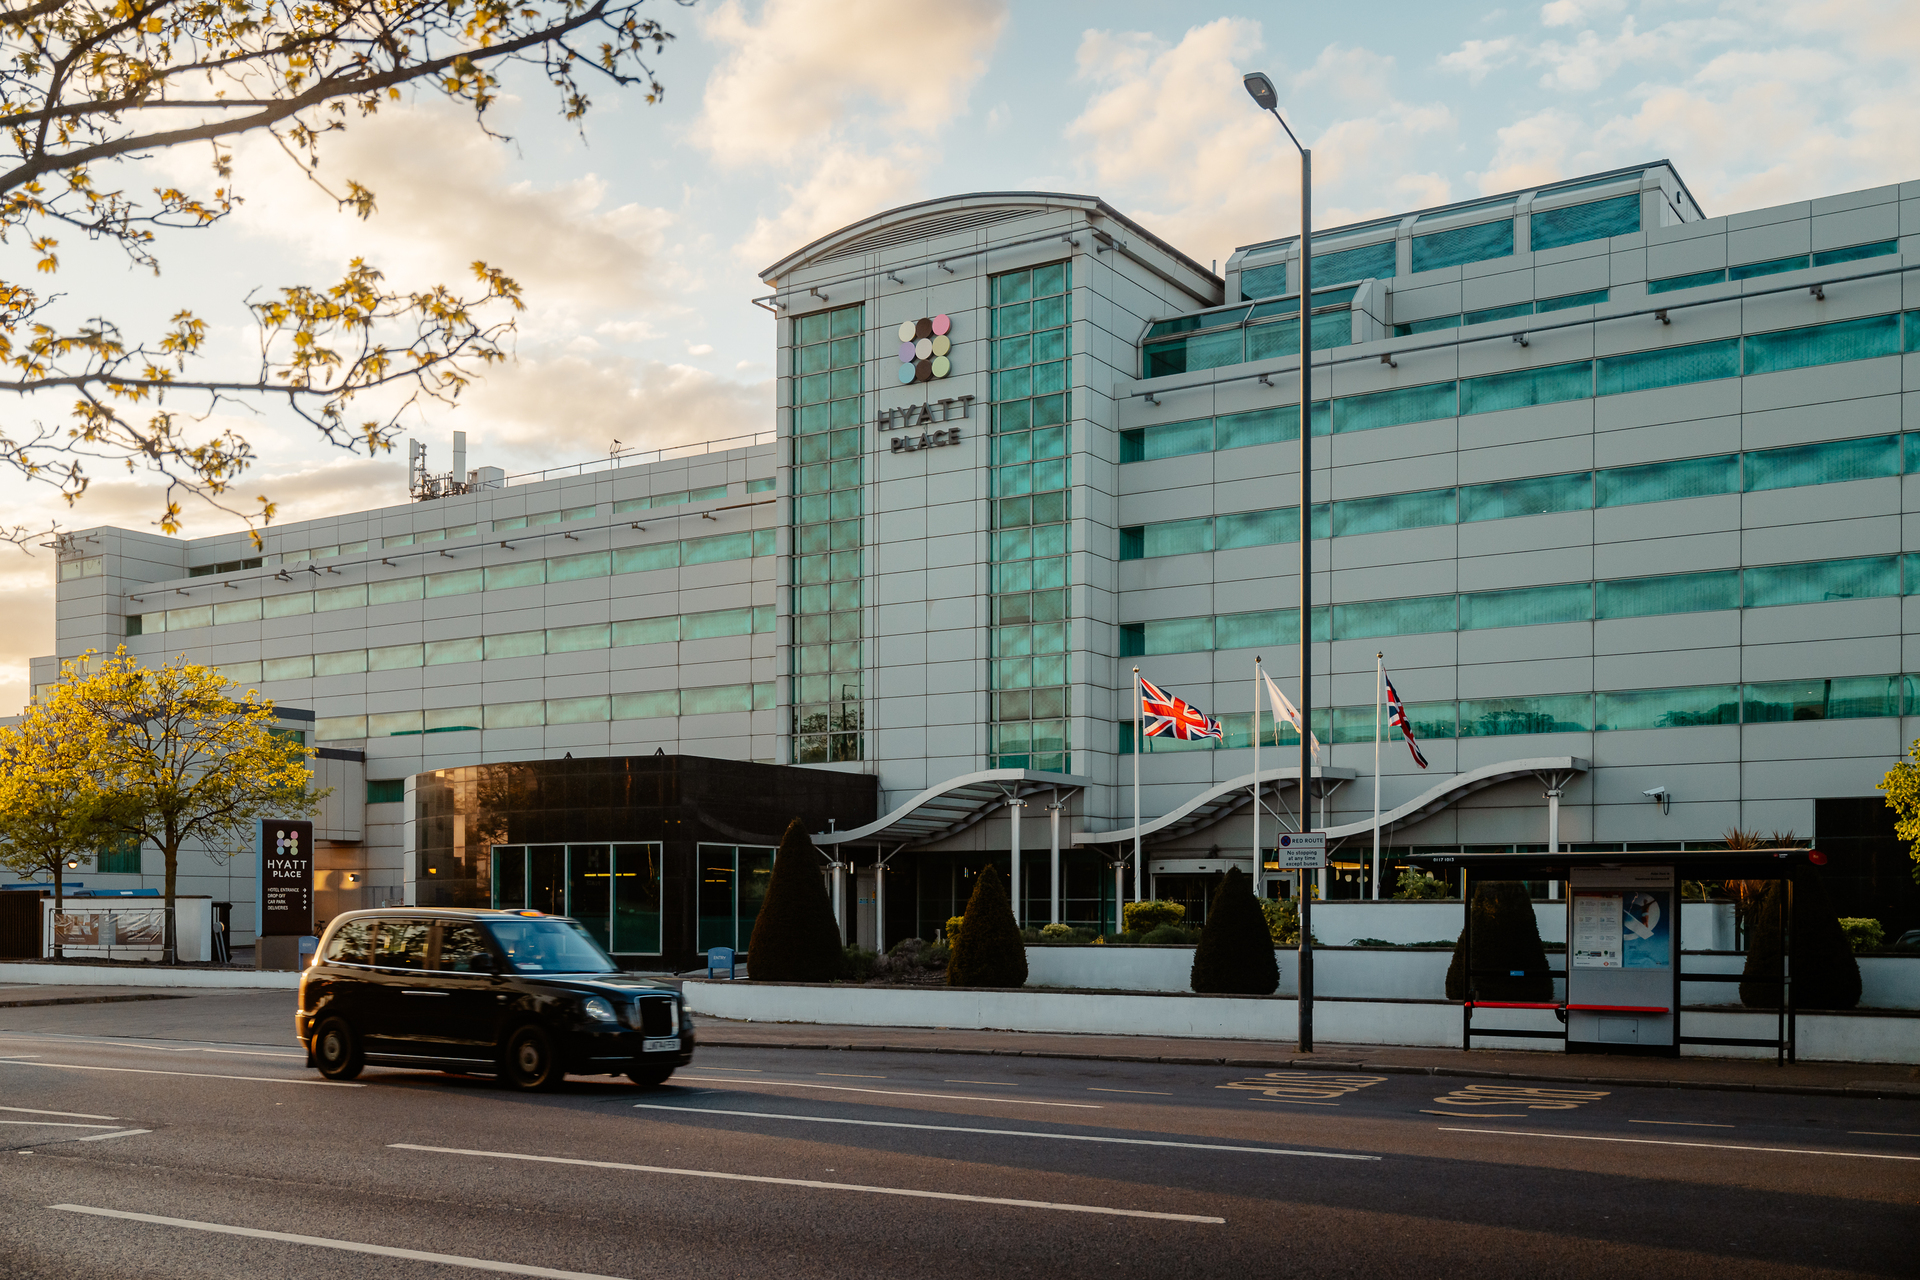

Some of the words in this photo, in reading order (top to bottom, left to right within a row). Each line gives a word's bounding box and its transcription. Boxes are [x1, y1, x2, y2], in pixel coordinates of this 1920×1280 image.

[878, 394, 975, 432] HYATT
[891, 427, 961, 454] PLACE
[267, 860, 307, 869] HYATT
[1434, 1084, 1612, 1110] BUS
